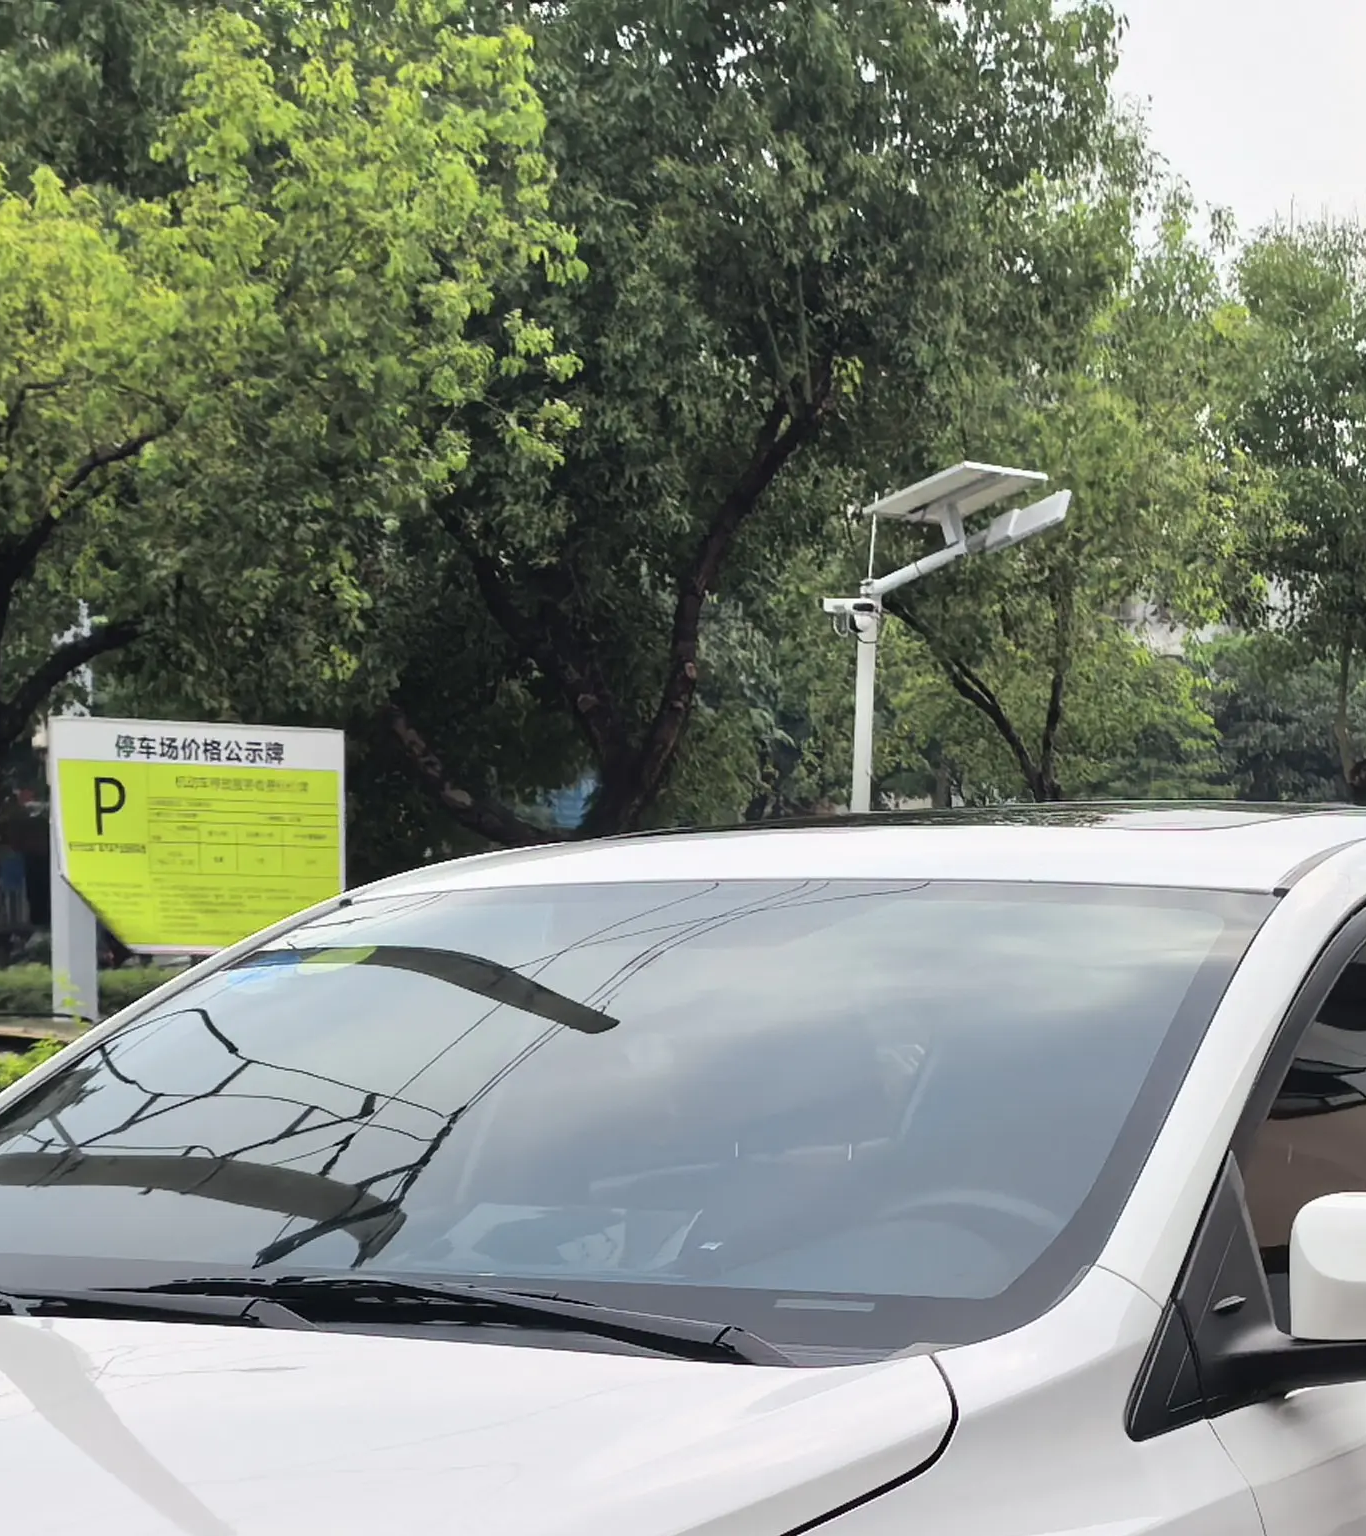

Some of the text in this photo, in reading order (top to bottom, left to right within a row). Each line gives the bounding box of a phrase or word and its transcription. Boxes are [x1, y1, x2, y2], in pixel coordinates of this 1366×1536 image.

[115, 734, 285, 765] 停车场价格公示牌
[94, 776, 126, 836] P
